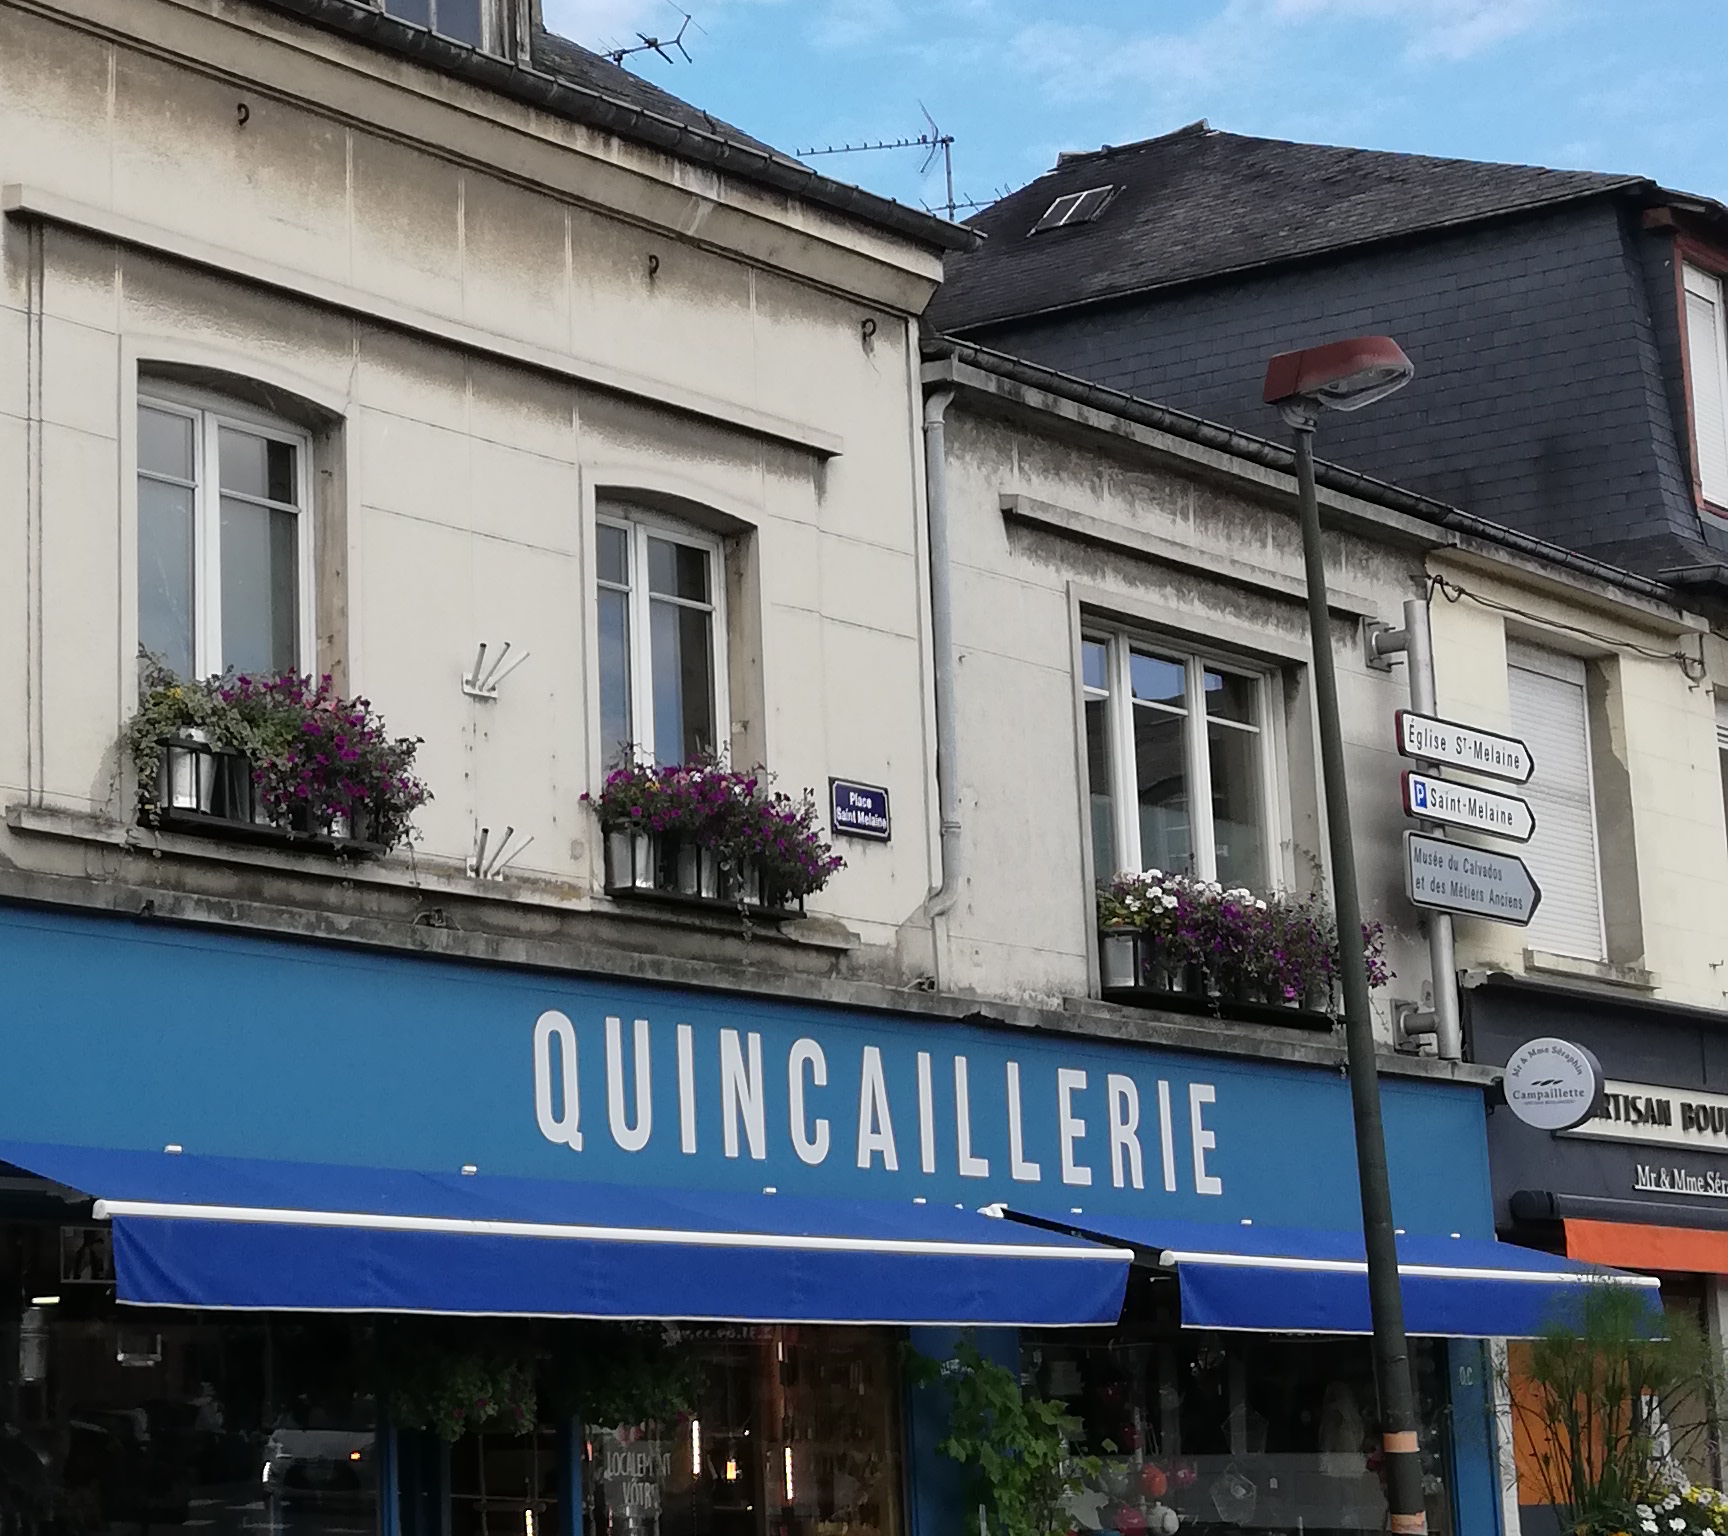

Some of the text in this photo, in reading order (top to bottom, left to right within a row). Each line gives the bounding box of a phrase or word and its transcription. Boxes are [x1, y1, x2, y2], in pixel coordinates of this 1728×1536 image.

[1409, 718, 1446, 751] Église
[849, 791, 872, 809] Place
[1430, 788, 1513, 826] Saint-Melaine
[836, 805, 887, 830] Saint Melaine
[1413, 846, 1503, 882] Musée du Calvados
[1415, 875, 1524, 911] et des Métiers Anciens
[1527, 1047, 1550, 1059] Mme
[533, 1010, 1222, 1196] QUINCAILLERIE
[1512, 1088, 1585, 1100] Campaillette
[1636, 1164, 1657, 1189] Mr
[1660, 1167, 1671, 1190] &
[1673, 1168, 1705, 1193] Mme
